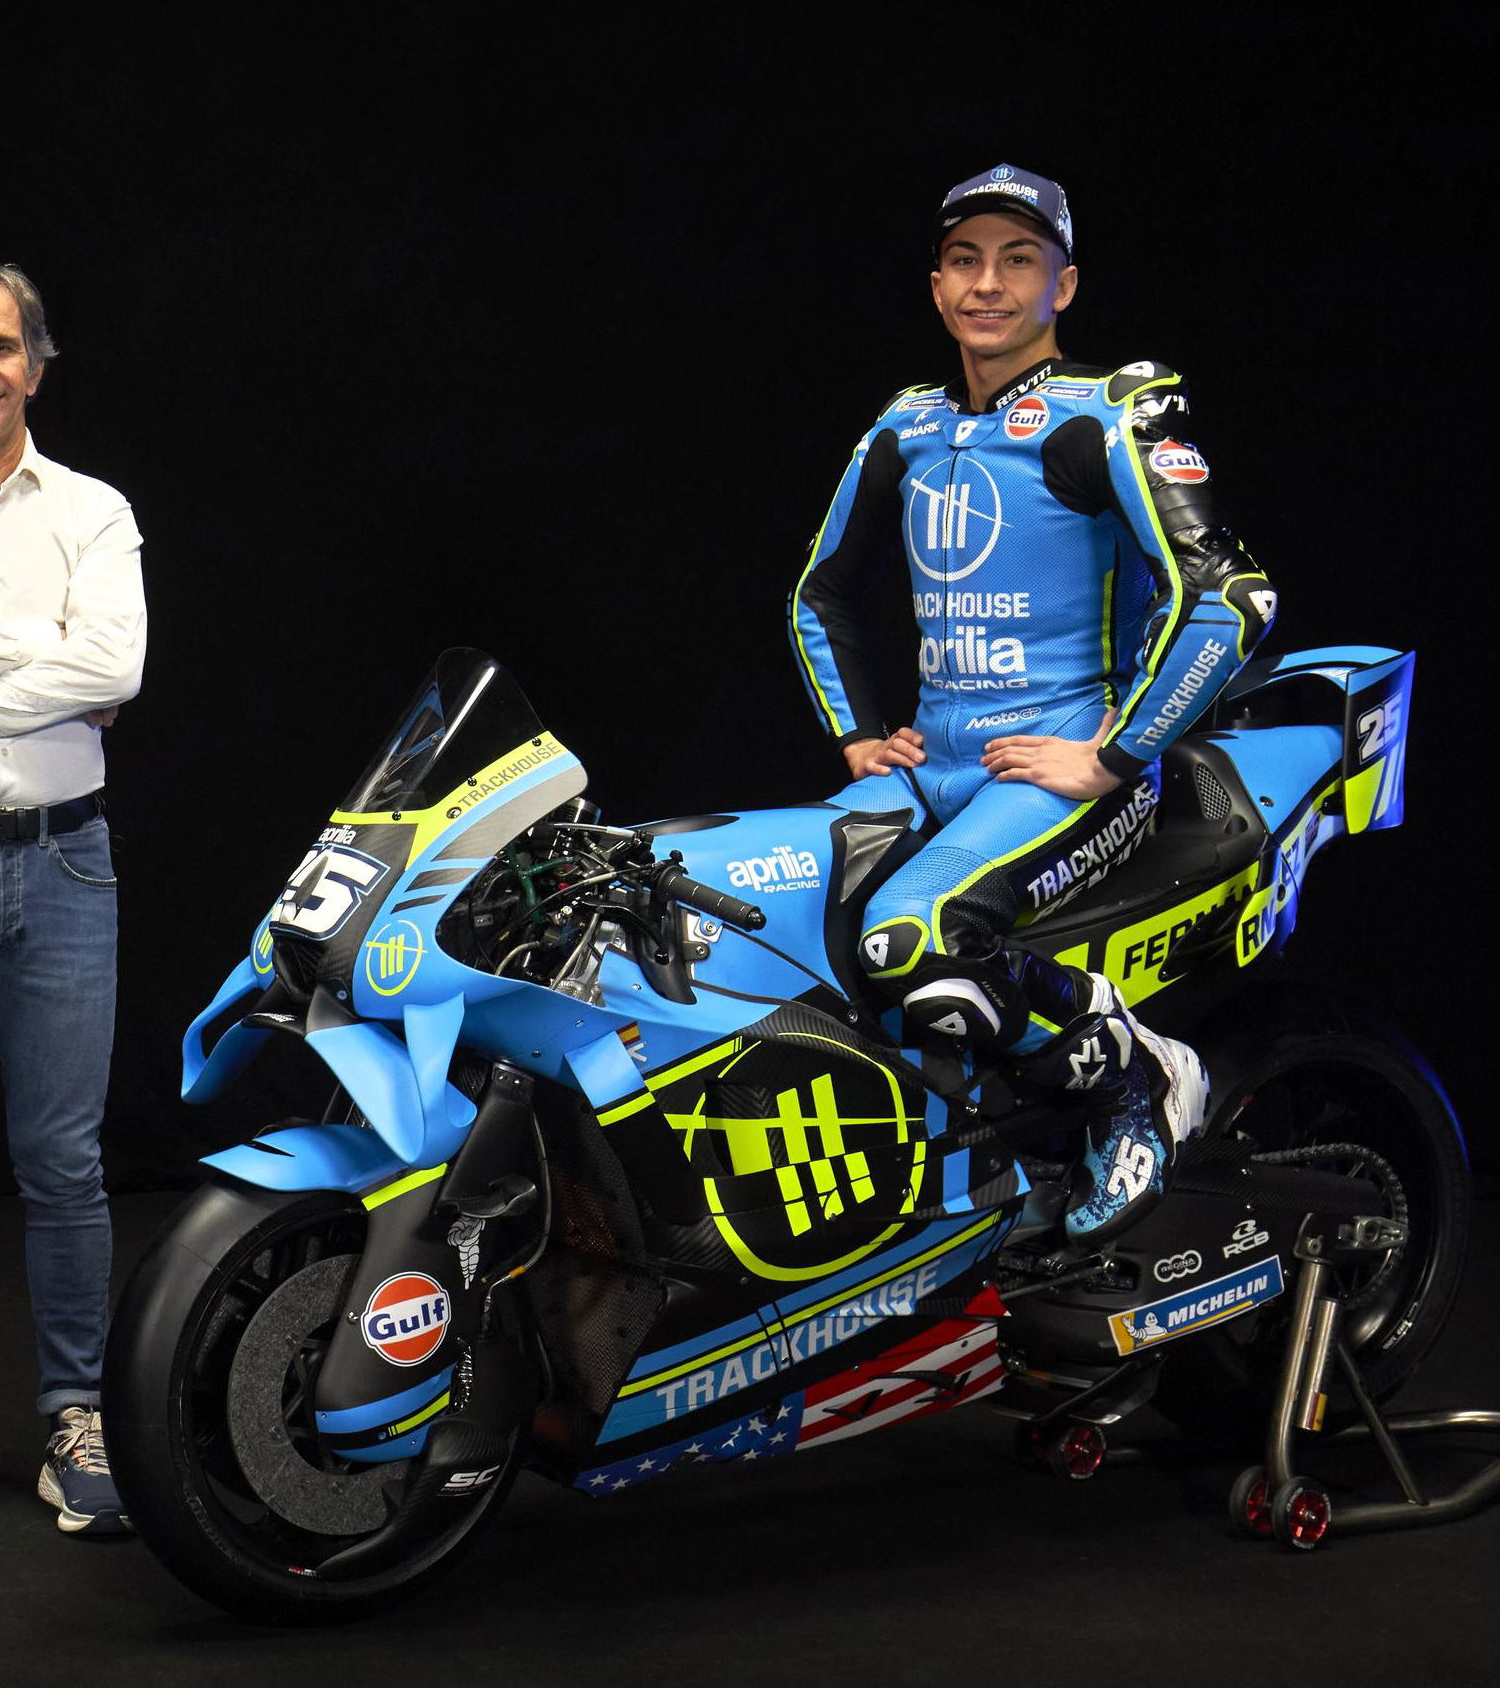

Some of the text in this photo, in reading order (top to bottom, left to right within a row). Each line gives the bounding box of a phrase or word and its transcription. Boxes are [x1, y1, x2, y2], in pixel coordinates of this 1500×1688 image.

[996, 364, 1052, 410] REV'IT!
[900, 420, 941, 440] SHARK
[1008, 411, 1047, 427] Gulf
[919, 625, 1027, 682] prilia
[932, 678, 1029, 690] RACING
[1136, 637, 1229, 749] TRACKHOUSE
[460, 742, 561, 807] TRACKHOUSE
[318, 824, 357, 845] aprilia
[1027, 781, 1160, 909] TRACKHOUSE
[726, 845, 819, 892] aprilia
[763, 879, 821, 894] RACING
[1106, 1134, 1156, 1203] 25
[1160, 1257, 1196, 1273] REGINA
[1223, 1230, 1270, 1259] RCB
[368, 1296, 446, 1344] Gulf
[1168, 1274, 1268, 1328] MICHELIN
[655, 1258, 943, 1423] TRACKHOUSE
[444, 1464, 501, 1488] SC
